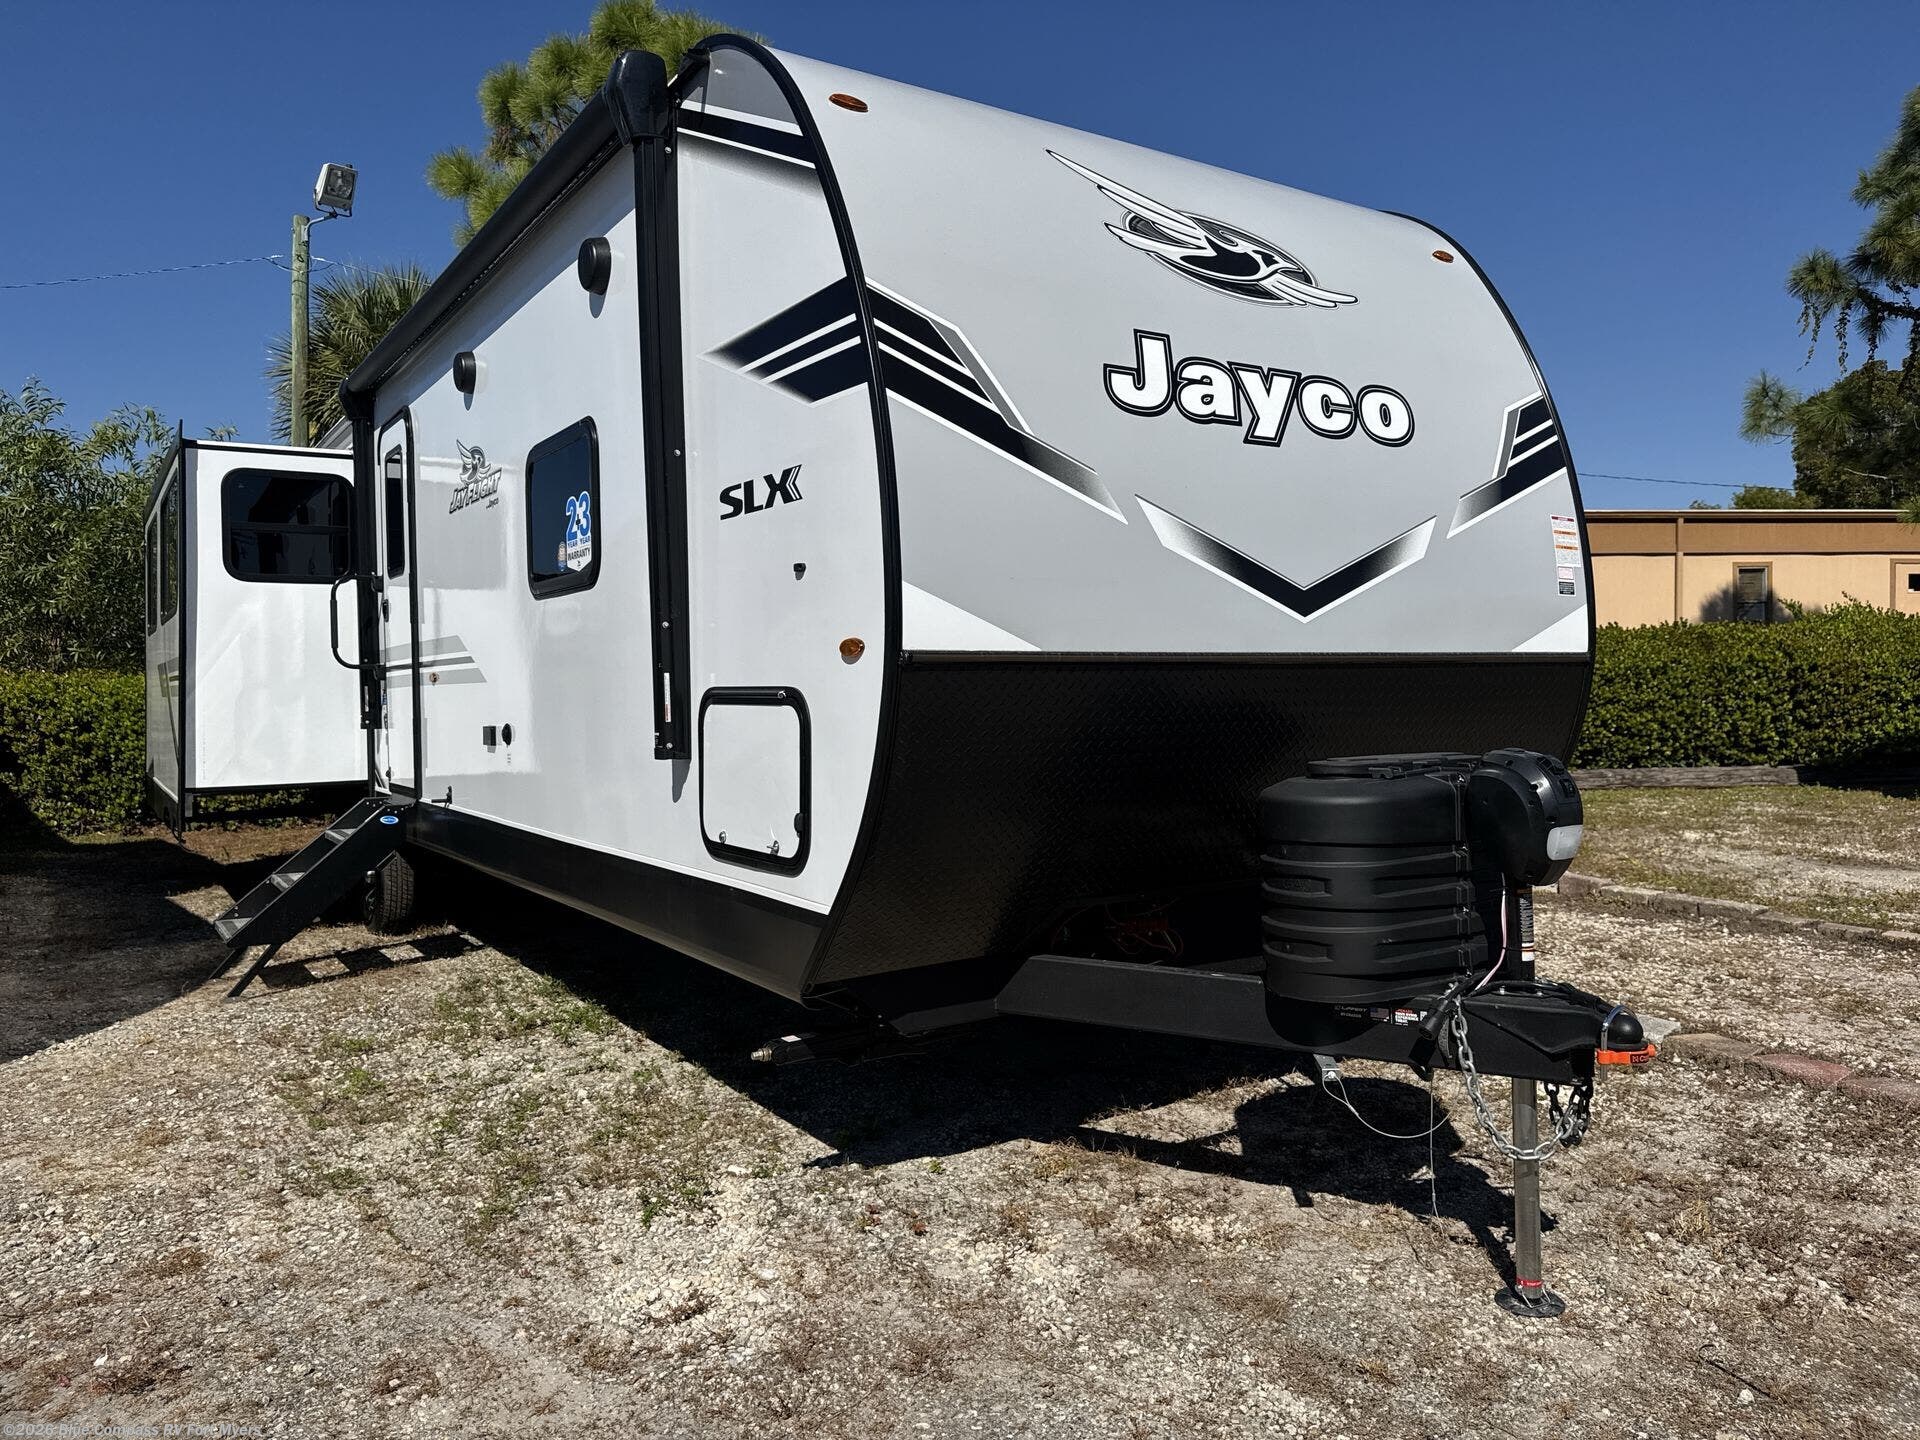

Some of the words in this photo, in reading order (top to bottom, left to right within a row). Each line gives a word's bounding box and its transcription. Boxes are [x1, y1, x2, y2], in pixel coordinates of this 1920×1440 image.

[1103, 328, 1415, 447] Jayco
[465, 467, 502, 507] FLIGHT
[719, 464, 803, 520] SLX
[568, 547, 591, 561] WARRANTY
